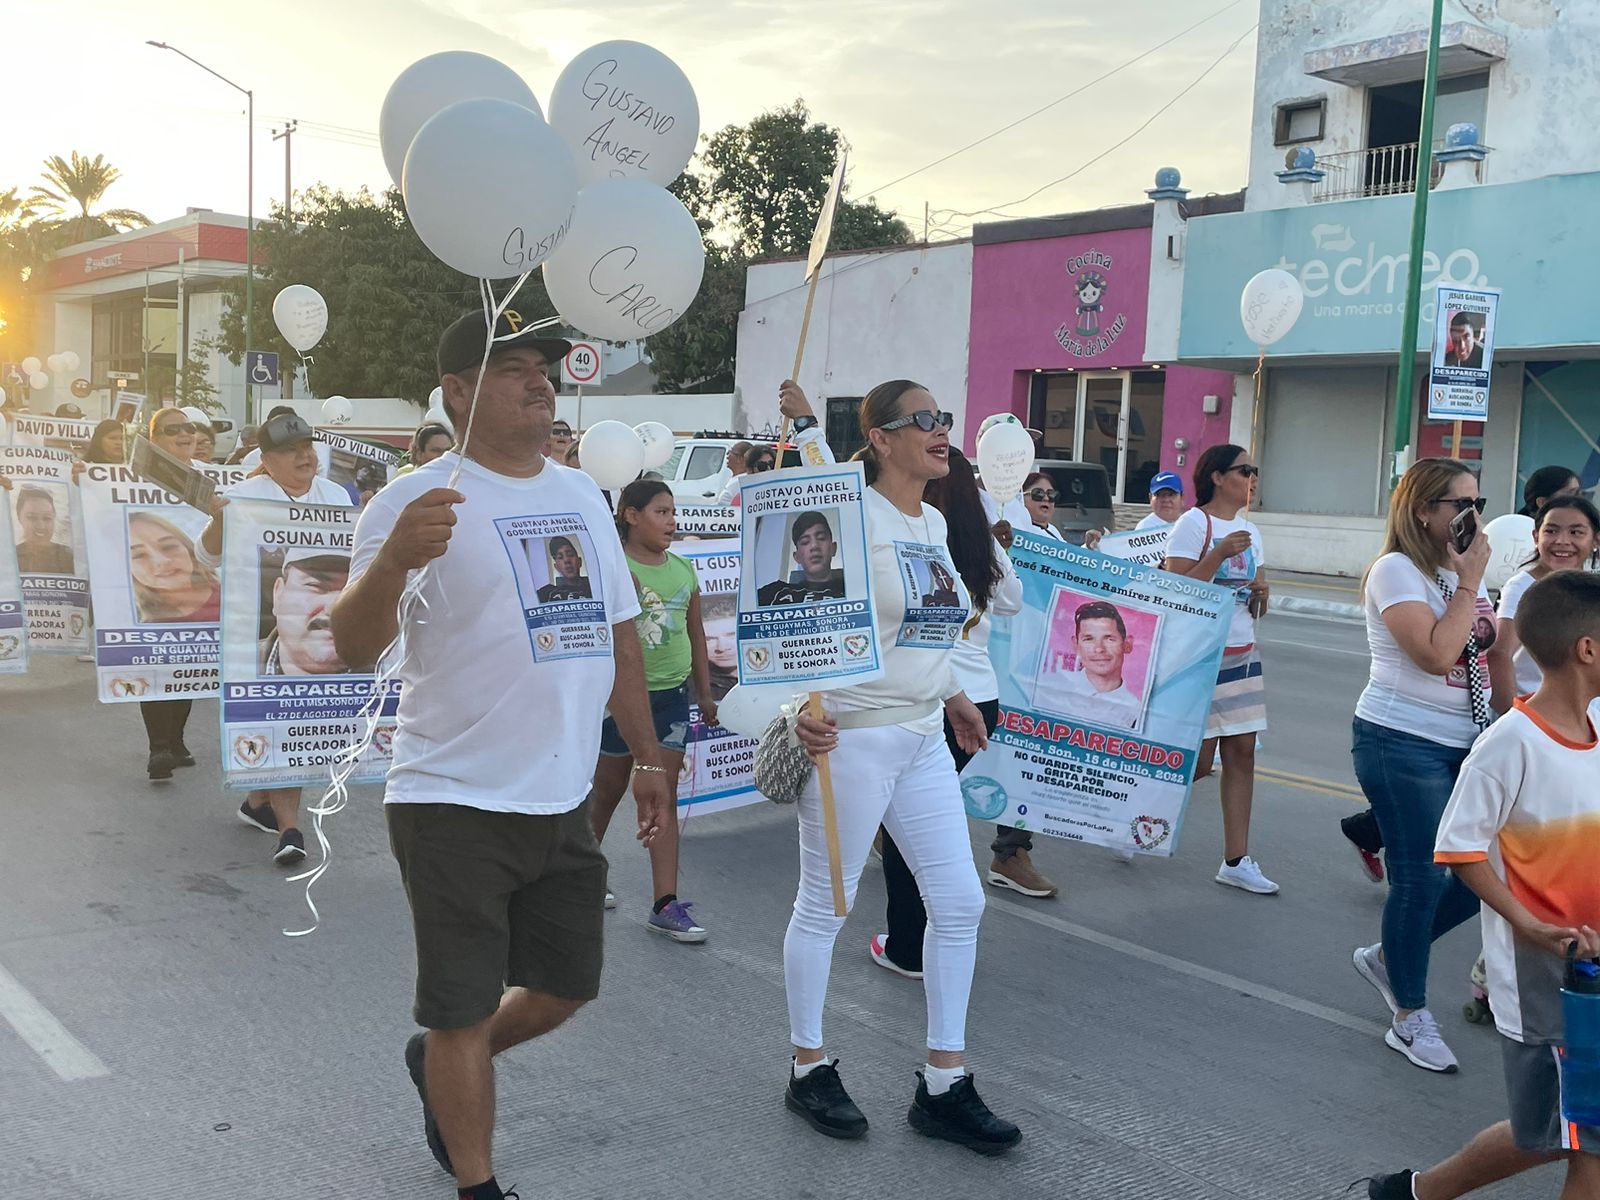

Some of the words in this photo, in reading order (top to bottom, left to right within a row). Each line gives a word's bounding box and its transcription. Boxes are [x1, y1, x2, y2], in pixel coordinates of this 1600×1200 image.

[581, 59, 675, 135] GUSTAVO
[582, 117, 649, 171] ANGEL
[1066, 248, 1113, 276] Cocina
[588, 245, 680, 330] CARLO
[1344, 303, 1393, 316] marca
[1085, 340, 1097, 357] de
[1097, 336, 1110, 353] la
[1105, 313, 1128, 343] Luz
[575, 352, 590, 366] 40
[1434, 368, 1488, 379] DESAPARECIDO
[16, 420, 54, 436] DAVID
[58, 423, 91, 440] VILLA
[313, 430, 347, 449] DAVID
[349, 440, 376, 461] VILLA
[37, 466, 60, 478] PAZ
[87, 465, 152, 484] CIN
[754, 485, 803, 501] GUSTAVO
[681, 507, 735, 518] RAMSÉS
[747, 499, 789, 514] GODINEZ
[289, 507, 352, 523] DANIEL
[511, 519, 550, 529] GUSTAVO
[262, 529, 325, 546] OSUNA
[1123, 551, 1151, 566] UGO
[1152, 550, 1167, 563] VA
[1013, 533, 1099, 569] Buscadoras
[1101, 559, 1126, 576] Por
[1128, 566, 1145, 582] La
[1146, 571, 1173, 590] Paz
[1173, 579, 1223, 604] Sonora
[1010, 555, 1037, 571] José
[1039, 564, 1099, 588] Heriberto
[1100, 581, 1151, 603] Ramírez
[1151, 595, 1218, 620] Hernández
[527, 602, 604, 618] DESAPARECIDO
[741, 601, 866, 624] DESAPARECIDO
[755, 631, 765, 639] EL
[767, 630, 778, 638] 30
[779, 629, 791, 637] DE
[792, 626, 818, 636] JUNIO
[819, 624, 835, 633] DEL
[836, 621, 857, 630] 2017
[759, 623, 771, 632] EN
[815, 616, 849, 626] SONORA
[151, 645, 167, 655] EN
[781, 635, 833, 649] GUERRERAS
[131, 655, 147, 665] 01
[149, 655, 164, 664] DE
[168, 653, 220, 664] SEPTIEM
[778, 646, 839, 659] BUSCADORAS
[783, 661, 795, 670] DE
[797, 658, 837, 669] SONORA
[279, 700, 293, 708] EN
[293, 700, 306, 708] LA
[306, 699, 330, 708] MISA
[329, 697, 366, 707] SONORA
[265, 712, 277, 720] EL
[277, 712, 289, 720] 27
[289, 711, 302, 719] DE
[302, 710, 337, 719] AGOSTO
[338, 709, 354, 718] DEL
[688, 711, 704, 722] S
[287, 723, 357, 737] GUERRERAS
[998, 706, 1186, 770] DESAPARECIDO
[288, 757, 304, 768] DE
[705, 750, 754, 768] BUSCADOR
[1004, 732, 1045, 754] Carlos,
[1047, 745, 1081, 763] Son.,
[1084, 752, 1100, 764] 15
[1102, 755, 1118, 769] de
[1118, 760, 1152, 778] julio,
[1154, 769, 1186, 785] 2022
[711, 769, 723, 780] DE
[1014, 750, 1029, 762] NO
[1030, 754, 1085, 775] GUARDES
[1085, 766, 1139, 788] SILENCIO,
[1044, 766, 1080, 784] GRITA
[1081, 775, 1105, 789] POR
[1020, 770, 1034, 781] TU
[1036, 773, 1129, 803] DESAPARECIDO!!
